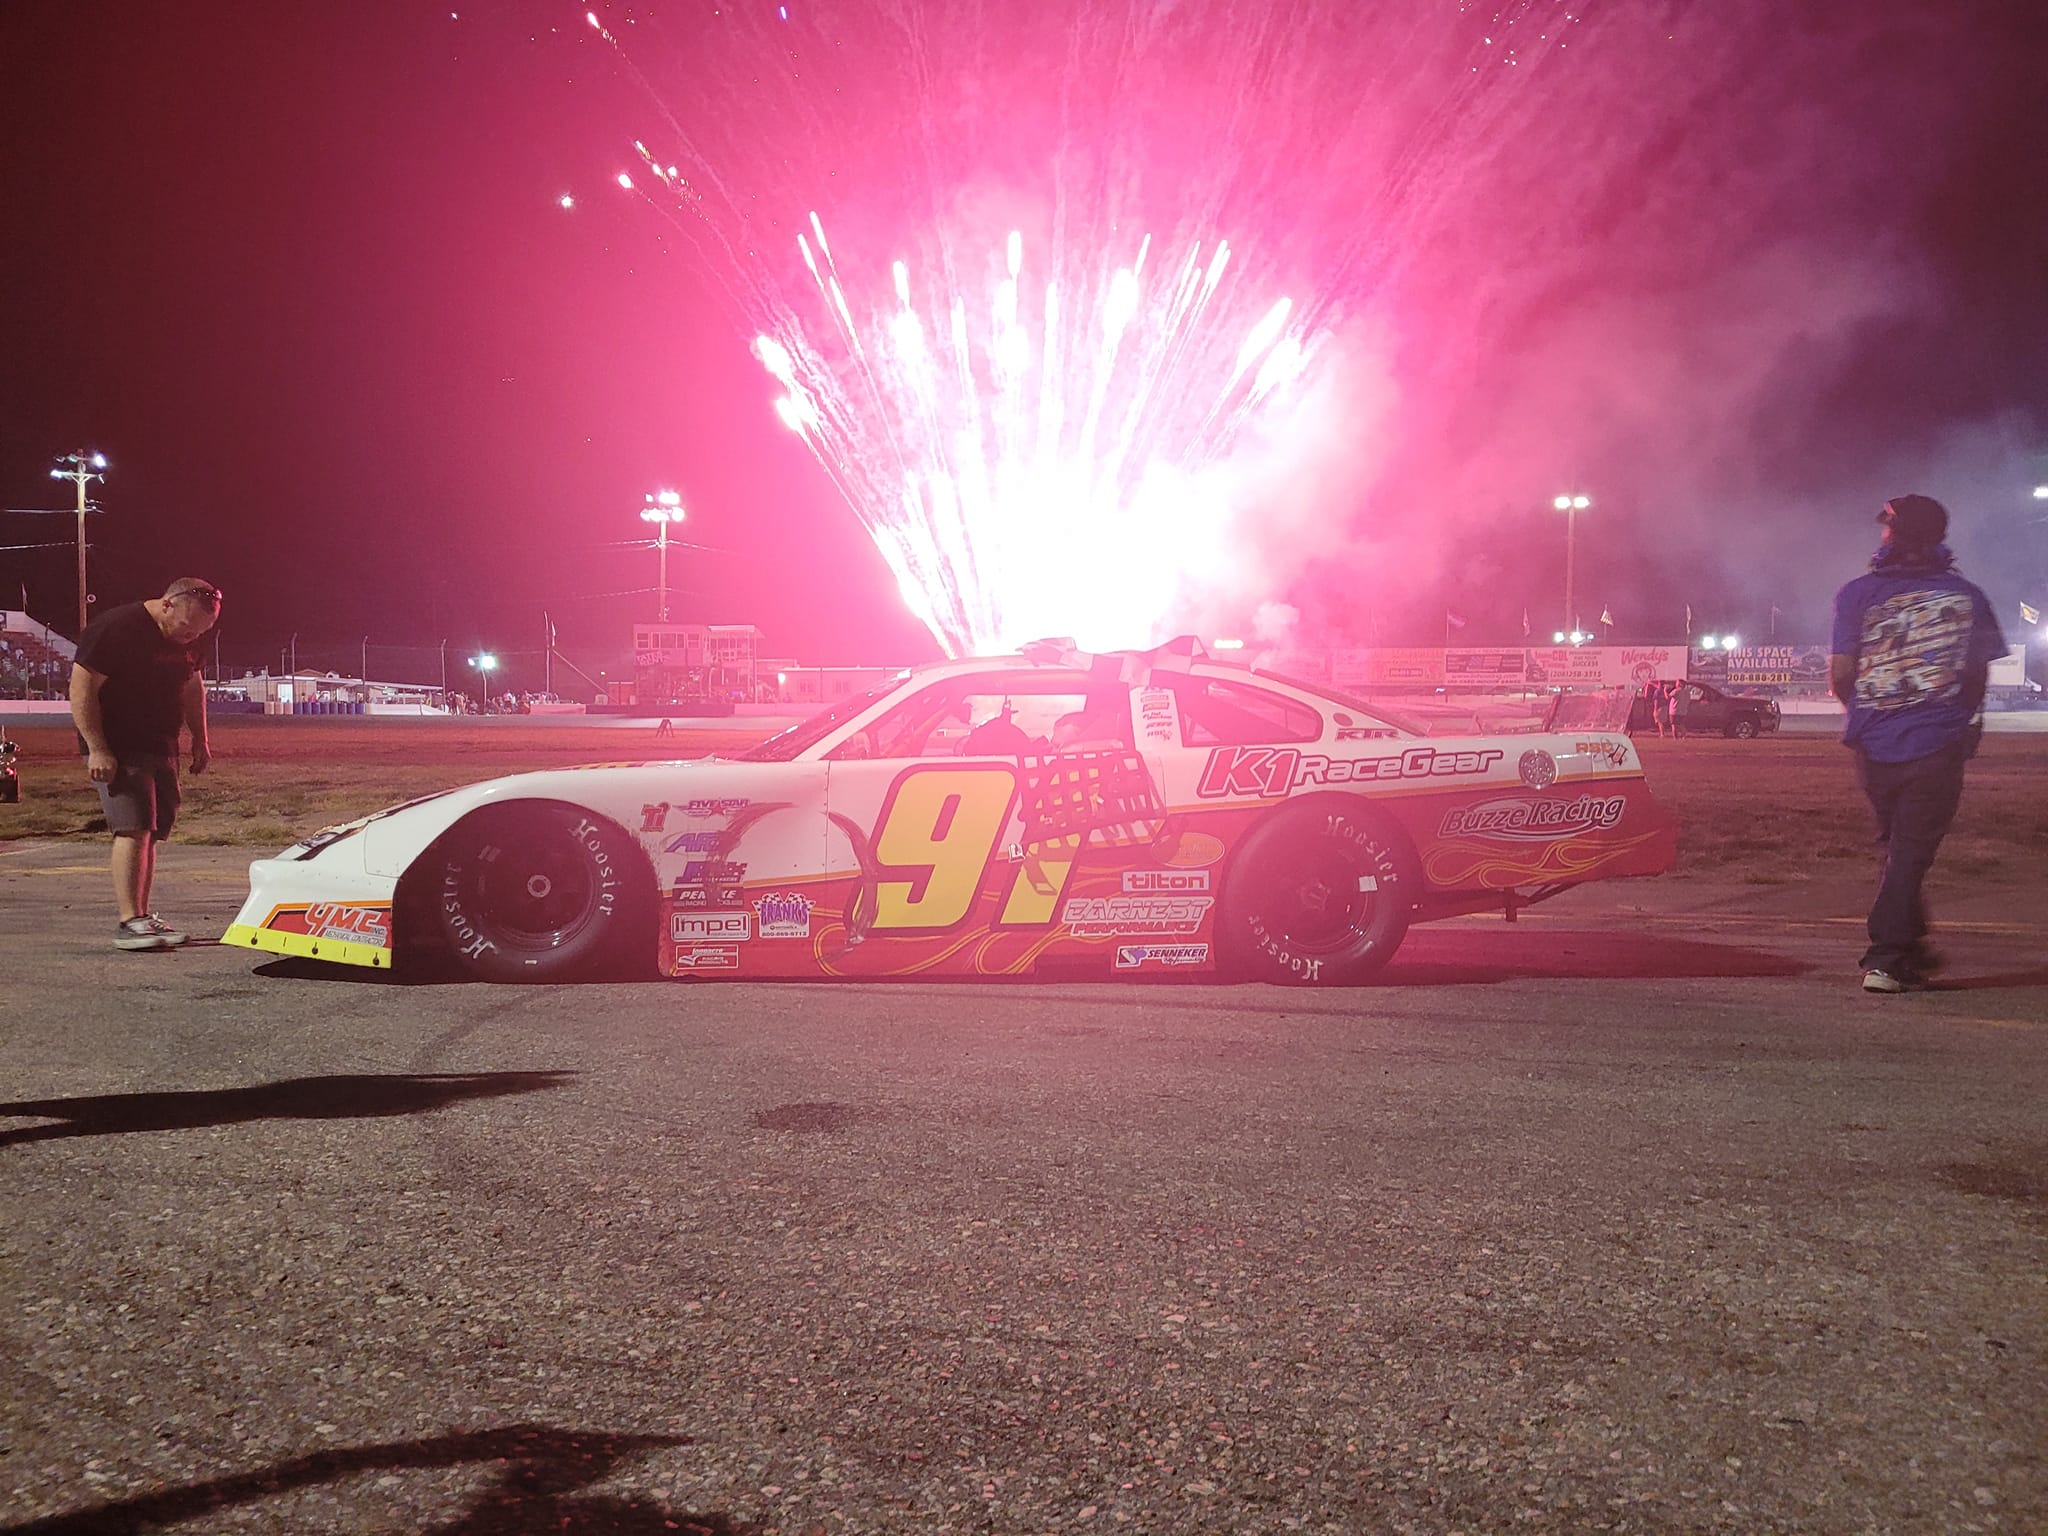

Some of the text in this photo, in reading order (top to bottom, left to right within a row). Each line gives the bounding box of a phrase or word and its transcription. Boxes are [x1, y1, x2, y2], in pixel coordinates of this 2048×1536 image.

[1621, 647, 1669, 665] Wendy's
[1728, 647, 1793, 657] THIS SPACE
[1527, 793, 1627, 831] Racing
[1320, 815, 1399, 882] Hoosier
[568, 819, 622, 916] Hoosier
[1127, 873, 1205, 889] tilton
[679, 890, 737, 900] PENKE
[1064, 900, 1211, 921] EARNEST
[1147, 948, 1207, 958] SENNEKER
[1248, 915, 1325, 981] Hoosier
